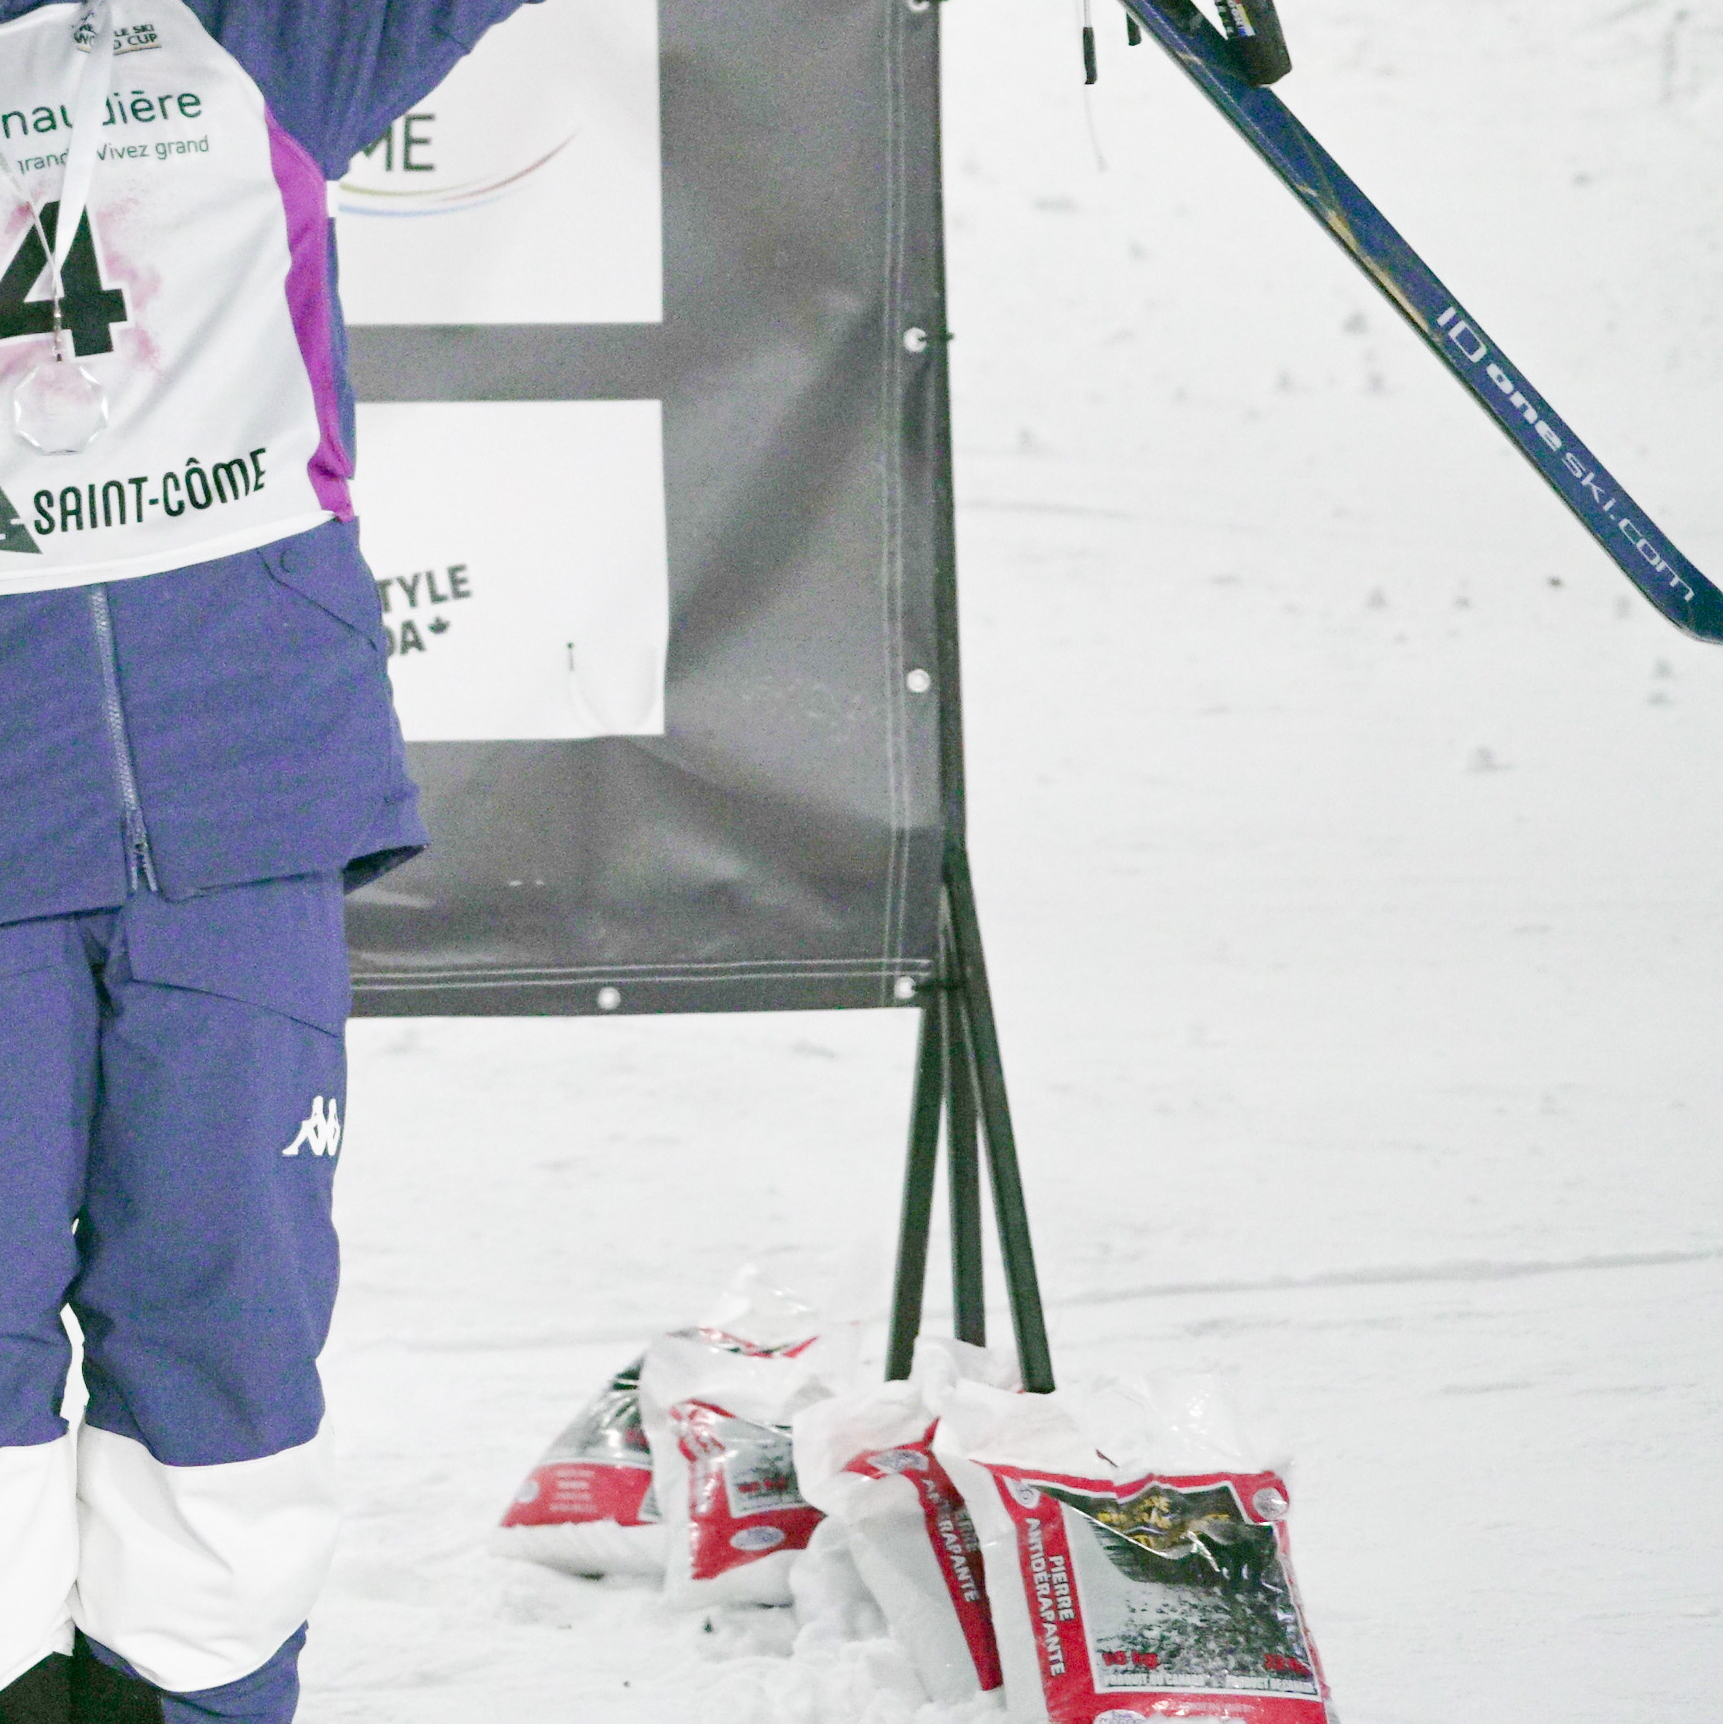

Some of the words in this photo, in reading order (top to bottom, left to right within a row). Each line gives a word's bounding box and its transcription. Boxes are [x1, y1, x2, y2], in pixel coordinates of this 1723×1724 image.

[128, 33, 158, 47] CUP
[97, 142, 148, 161] Vivez
[155, 135, 211, 170] grand
[1026, 1517, 1066, 1677] ANTIDÉRAPANTE
[1049, 1555, 1075, 1622] PIERRE
